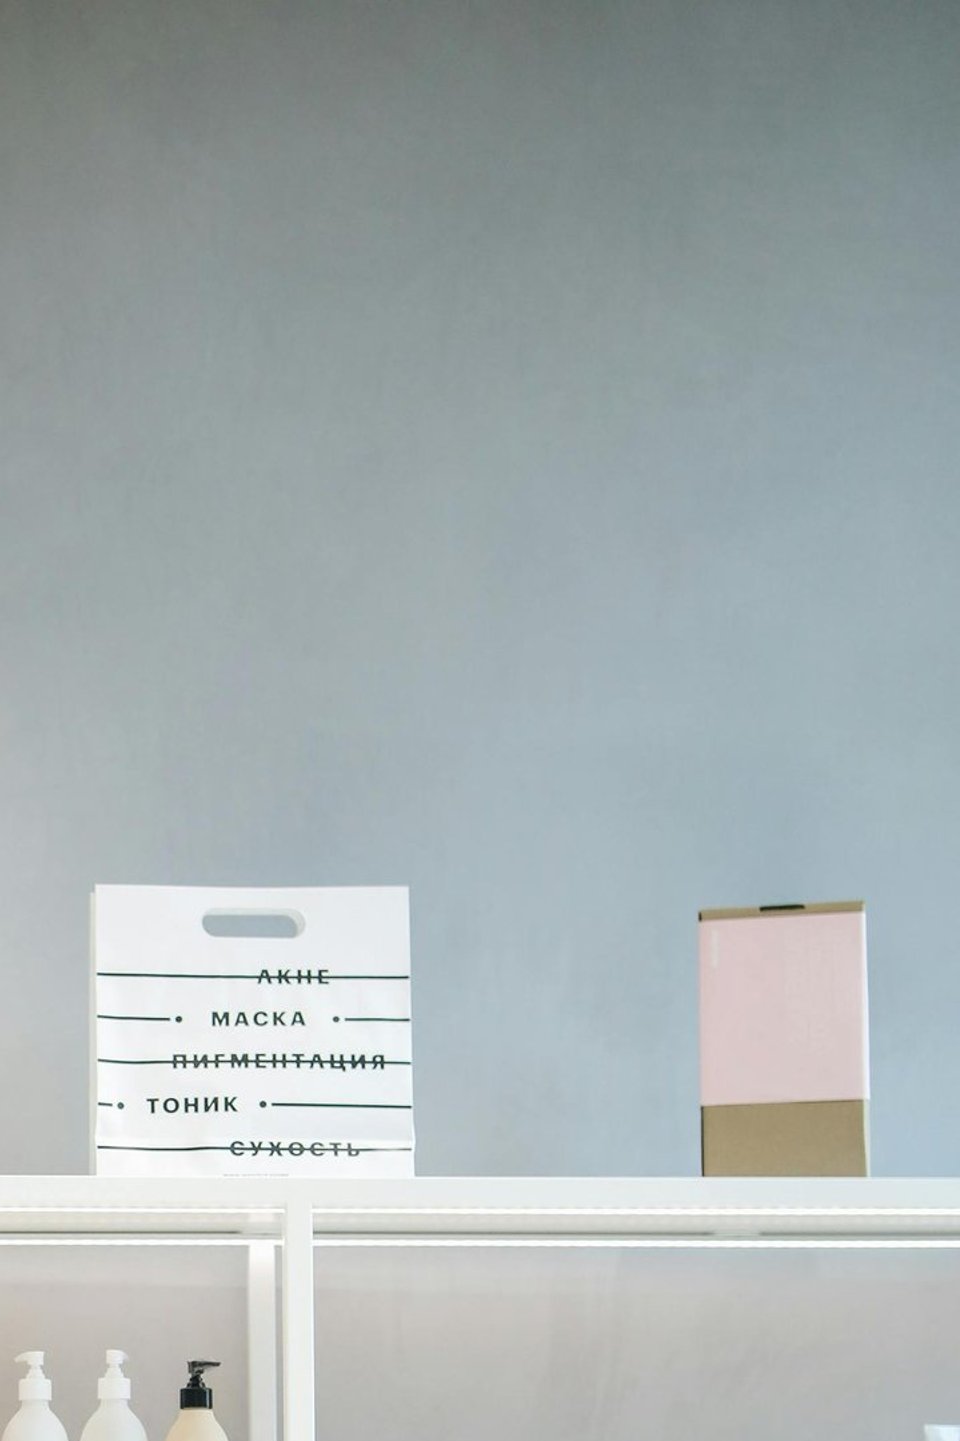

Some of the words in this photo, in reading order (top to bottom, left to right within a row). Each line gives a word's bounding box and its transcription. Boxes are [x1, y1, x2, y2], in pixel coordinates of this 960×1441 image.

[257, 969, 330, 985] АКНЕ
[211, 1011, 306, 1026] МАСКА
[172, 1054, 385, 1071] ПИГМЕНТАЦИЯ
[146, 1097, 239, 1113] ТОНИК
[229, 1141, 360, 1157] СУХОСТЬ
